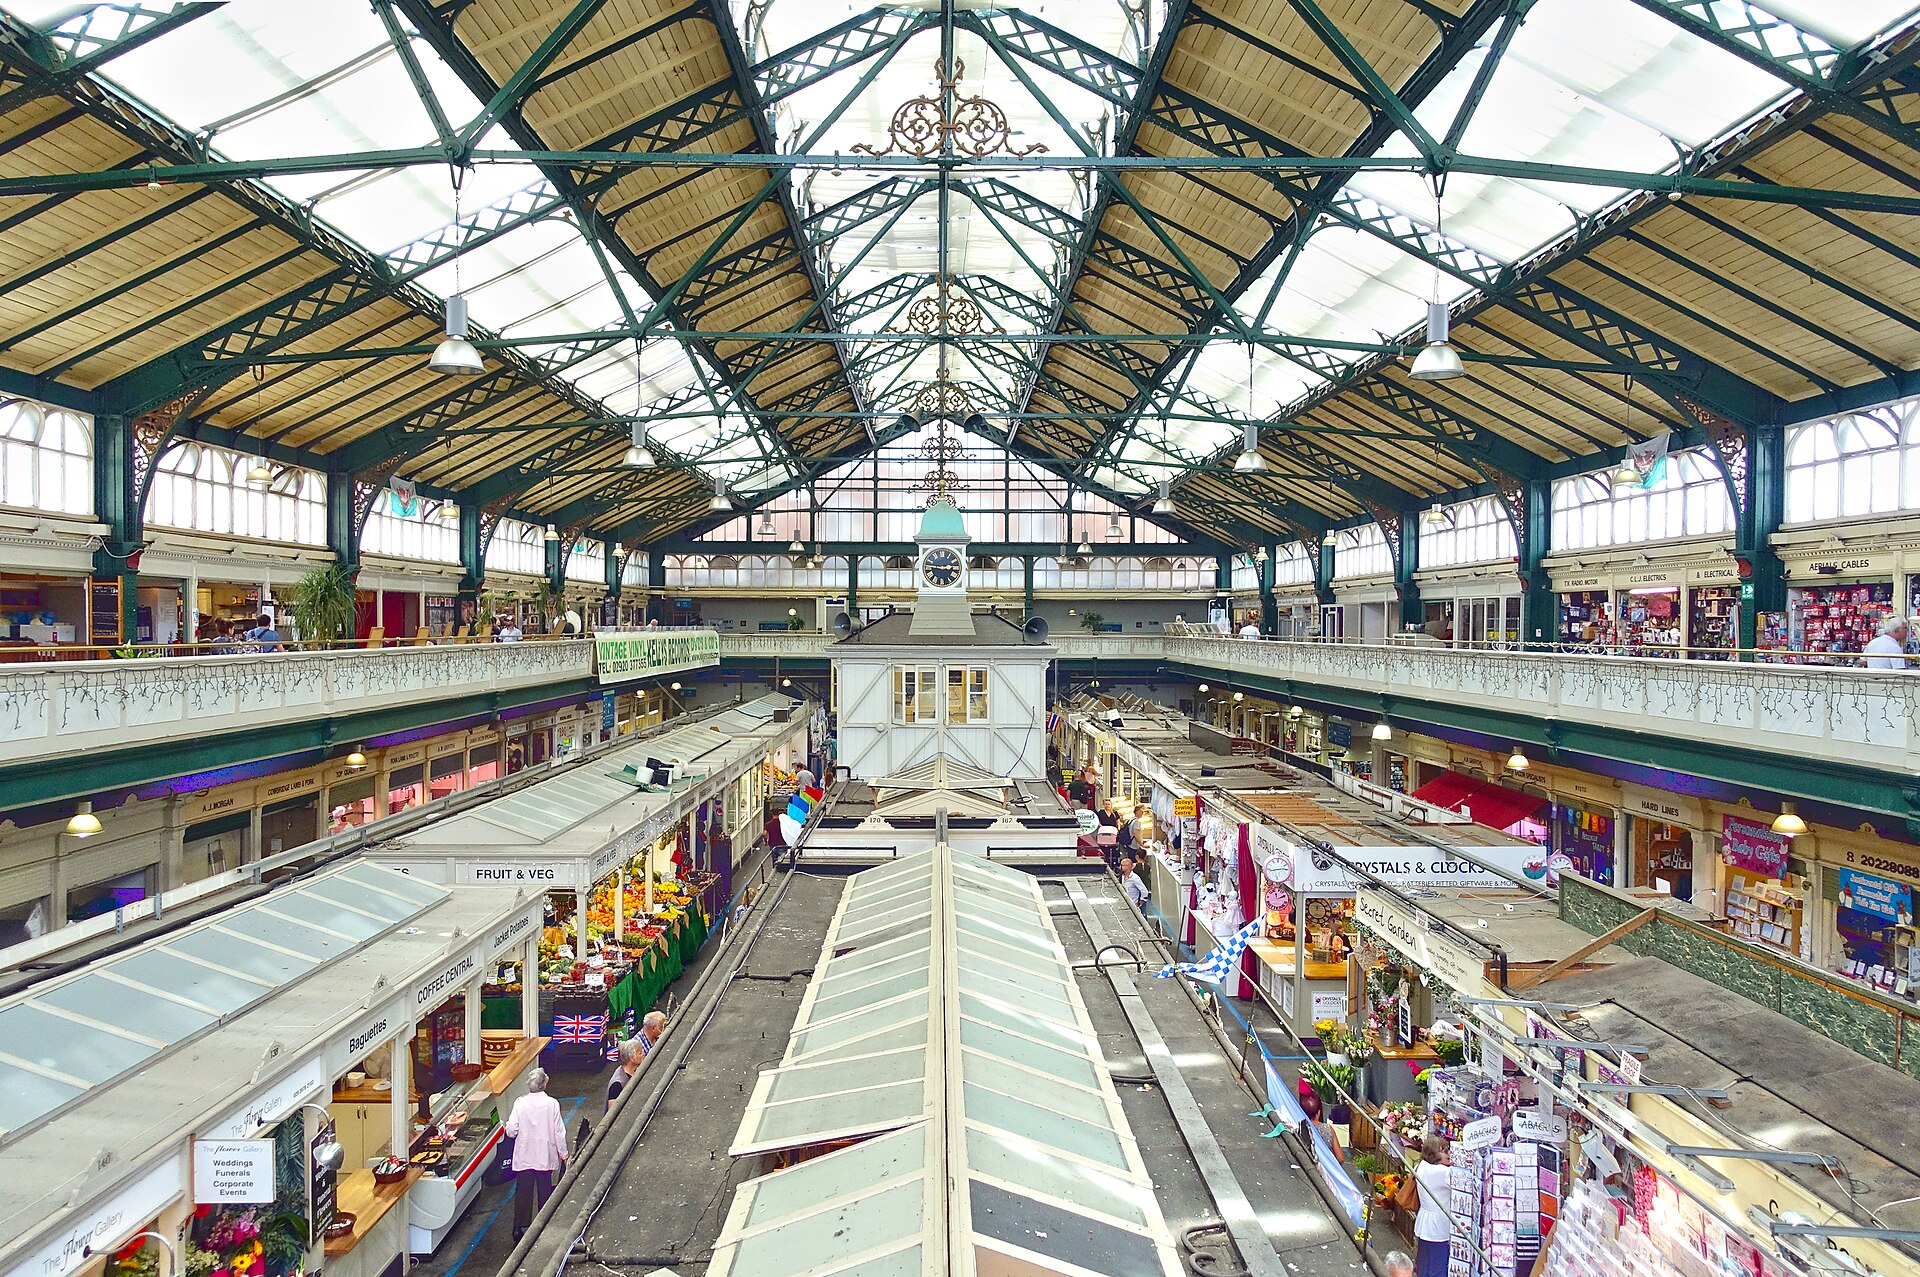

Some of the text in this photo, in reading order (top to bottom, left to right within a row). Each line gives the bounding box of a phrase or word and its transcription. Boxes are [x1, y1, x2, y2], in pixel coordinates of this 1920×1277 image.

[1841, 559, 1869, 569] CABLES
[1643, 574, 1667, 582] ELECTRICS
[1704, 569, 1734, 578] ELECTRICAL
[598, 640, 647, 660] VINTAGE VINYL
[668, 637, 690, 665] RECORDS
[335, 770, 343, 779] TOP
[268, 784, 290, 797] COWBRIDGE
[305, 778, 314, 787] PORK
[1641, 800, 1680, 817] HARD LINES
[1755, 844, 1781, 866] Gifts
[476, 869, 555, 880] FRUIT & VEG
[1415, 862, 1427, 874] &
[1430, 861, 1486, 874] CLOCKS
[1360, 897, 1417, 951] Secret Garden
[494, 916, 529, 948] Jacket Potatoes
[417, 955, 473, 1004] COFFEE CENTRAL
[349, 1018, 387, 1054] Baguettes
[1622, 1053, 1640, 1071] FRAGILE
[1624, 1064, 1636, 1078] ROOF
[231, 1124, 243, 1138] The
[202, 1145, 214, 1153] The
[242, 1145, 264, 1154] Gallery
[213, 1159, 254, 1167] Weddings
[215, 1169, 251, 1177] Funerals
[213, 1180, 254, 1189] Corporate
[42, 1255, 61, 1275] The
[94, 1210, 124, 1237] Gallery
